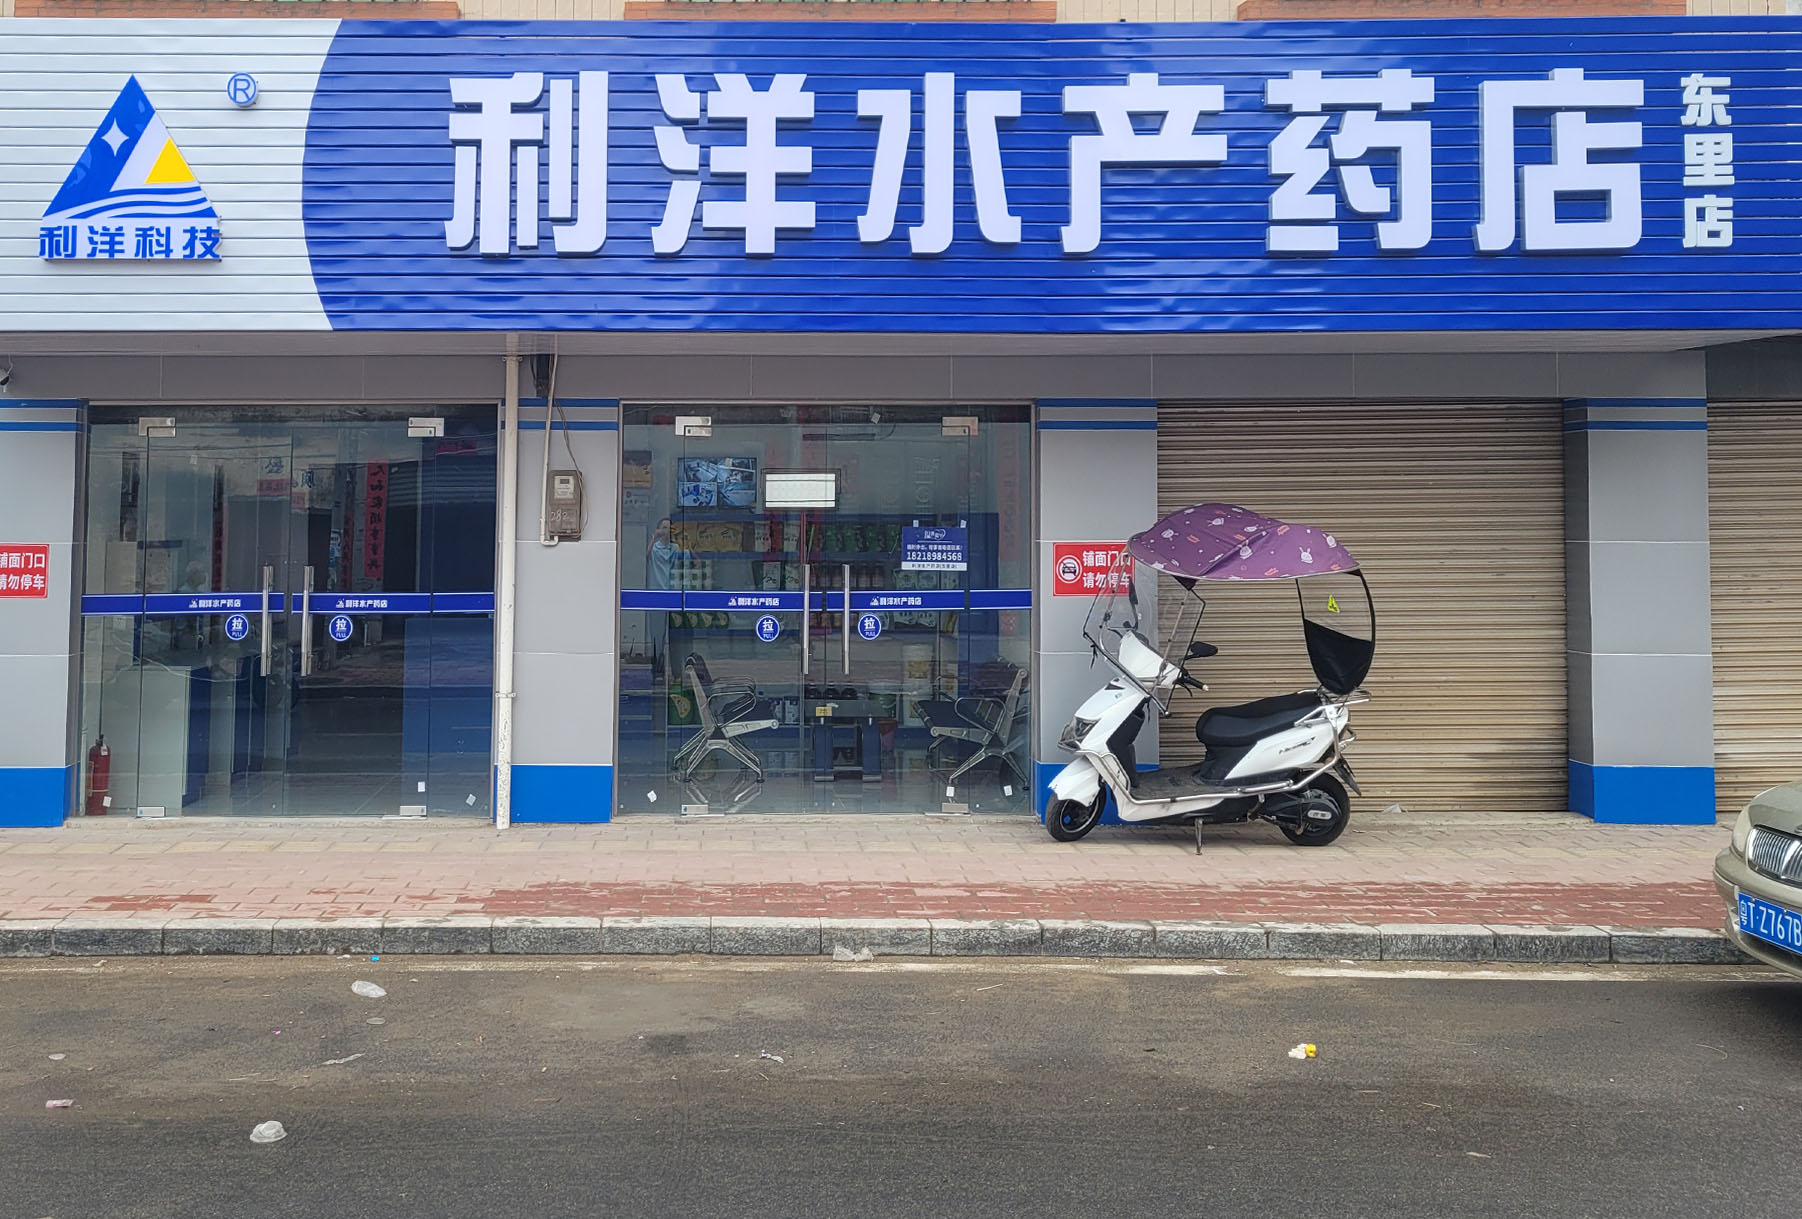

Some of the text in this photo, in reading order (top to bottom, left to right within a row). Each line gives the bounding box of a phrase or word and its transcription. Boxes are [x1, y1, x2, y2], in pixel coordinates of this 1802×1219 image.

[443, 68, 1644, 256] 利洋水产药店
[1680, 73, 1735, 249] 东里店
[39, 225, 222, 259] 利洋科技
[907, 552, 962, 561] 18218984568
[1083, 551, 1131, 567] 铺面门口
[1083, 572, 1130, 588] 请勿停车
[232, 617, 243, 630] 拉
[336, 618, 347, 631] 拉
[763, 619, 774, 632] 拉
[864, 617, 876, 630] 拉
